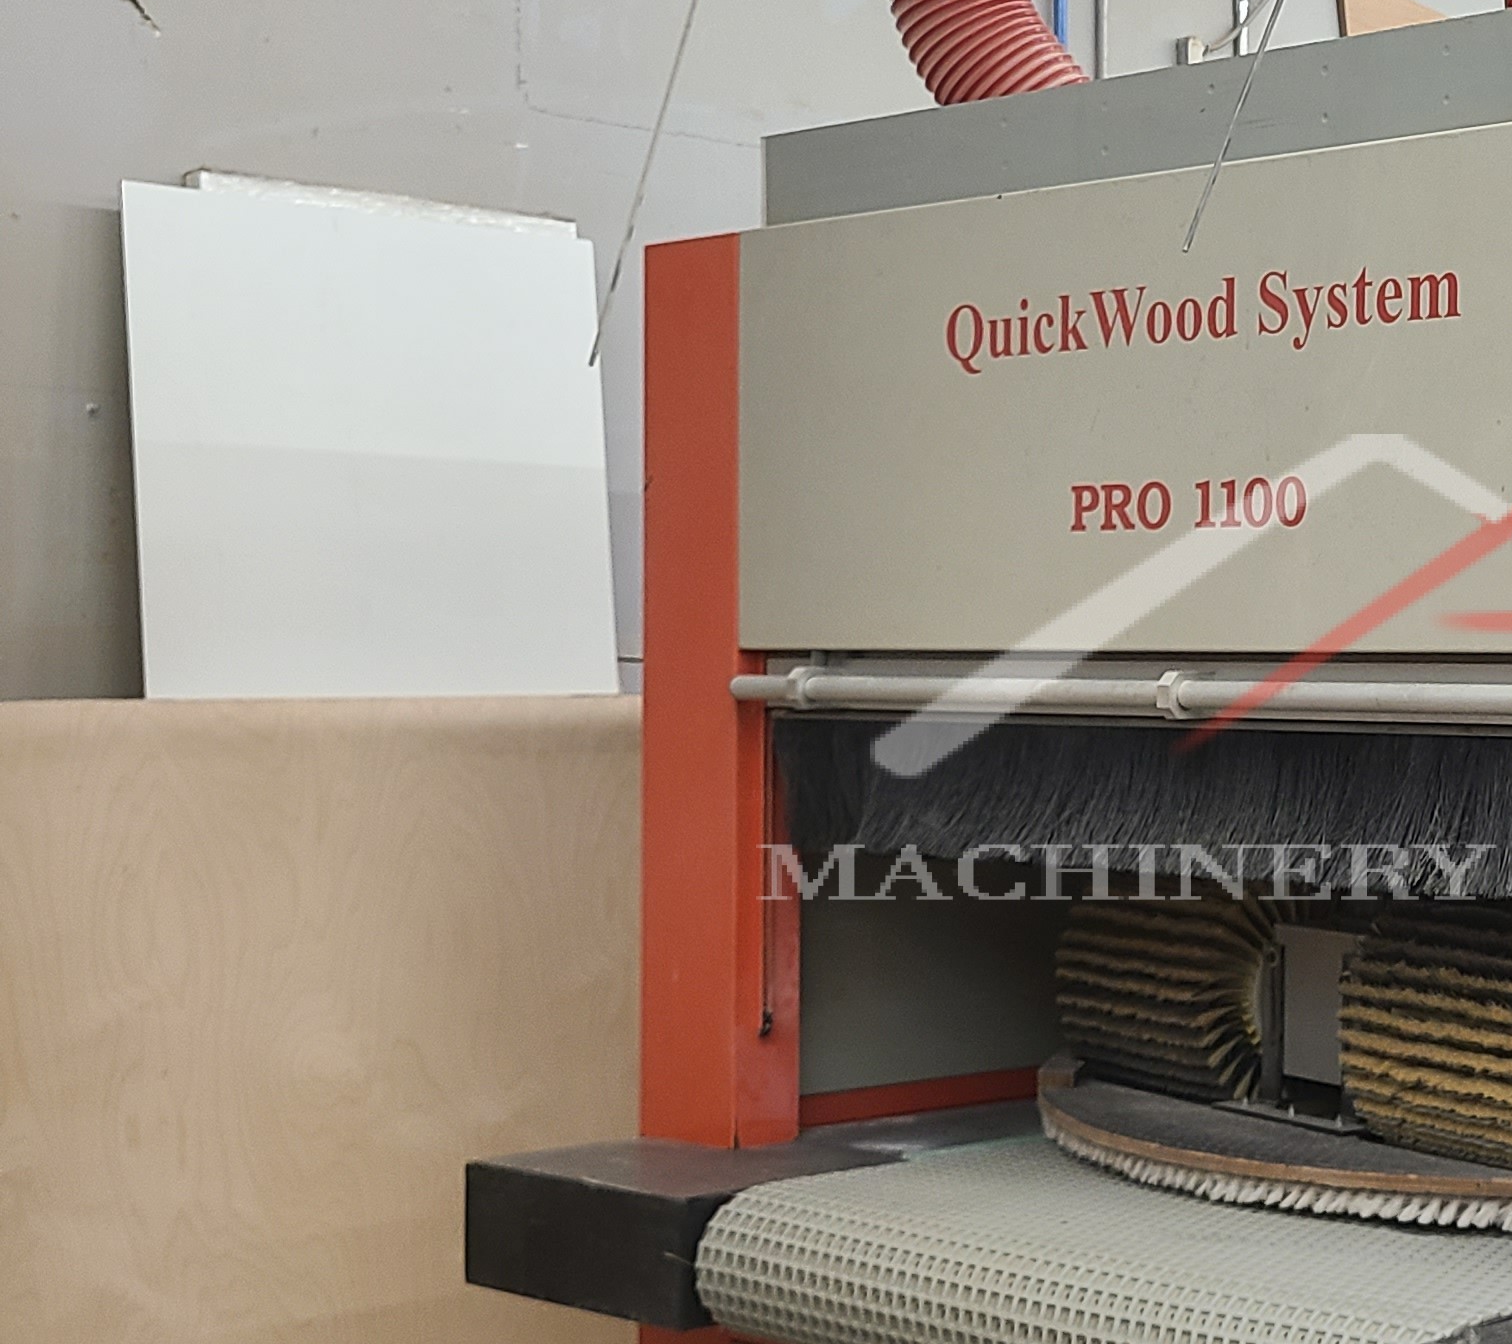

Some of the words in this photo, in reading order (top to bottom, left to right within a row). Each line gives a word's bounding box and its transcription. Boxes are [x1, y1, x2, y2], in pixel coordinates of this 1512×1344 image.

[947, 277, 1239, 375] QuickWood
[1257, 266, 1462, 351] System
[1069, 481, 1171, 533] PRO
[1194, 476, 1308, 529] 1100
